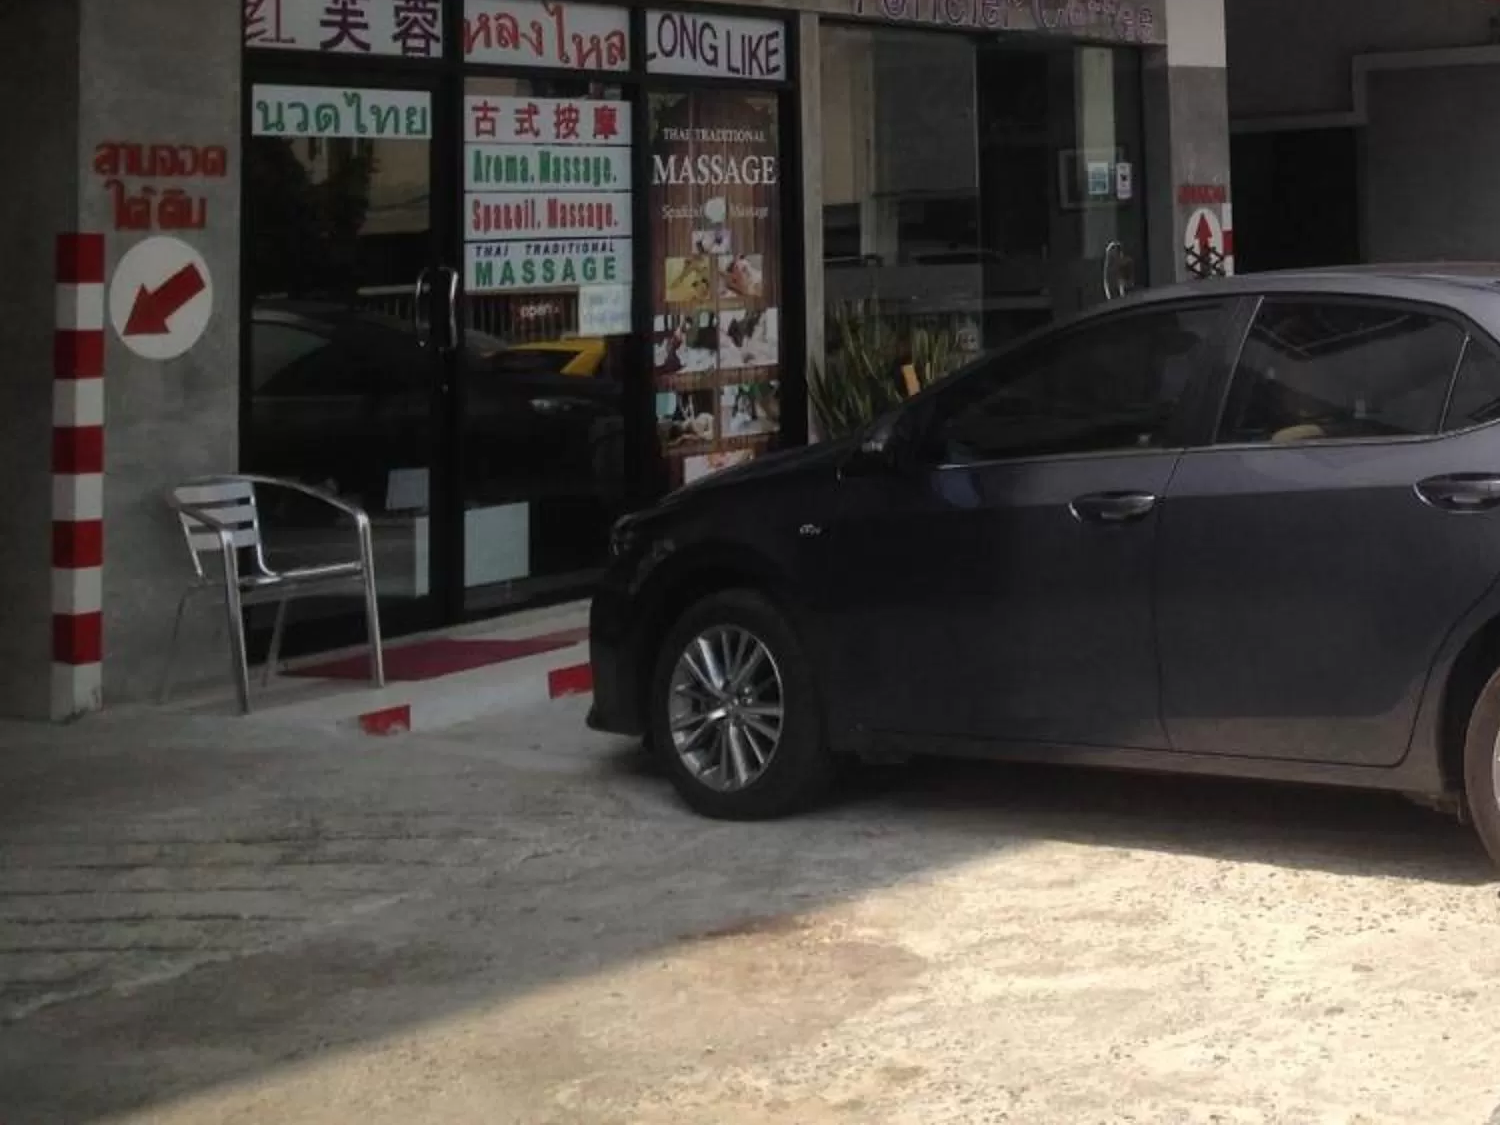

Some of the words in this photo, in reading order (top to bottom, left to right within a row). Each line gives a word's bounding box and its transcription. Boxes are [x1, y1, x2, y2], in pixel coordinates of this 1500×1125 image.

[725, 29, 786, 75] LIKE
[255, 90, 428, 136] นวดไทย
[471, 100, 619, 140] 古式按摩
[652, 154, 777, 186] MASSAGE
[474, 245, 509, 258] THAI
[525, 241, 616, 256] TRADITIONAL
[475, 256, 617, 287] MASSAGE
